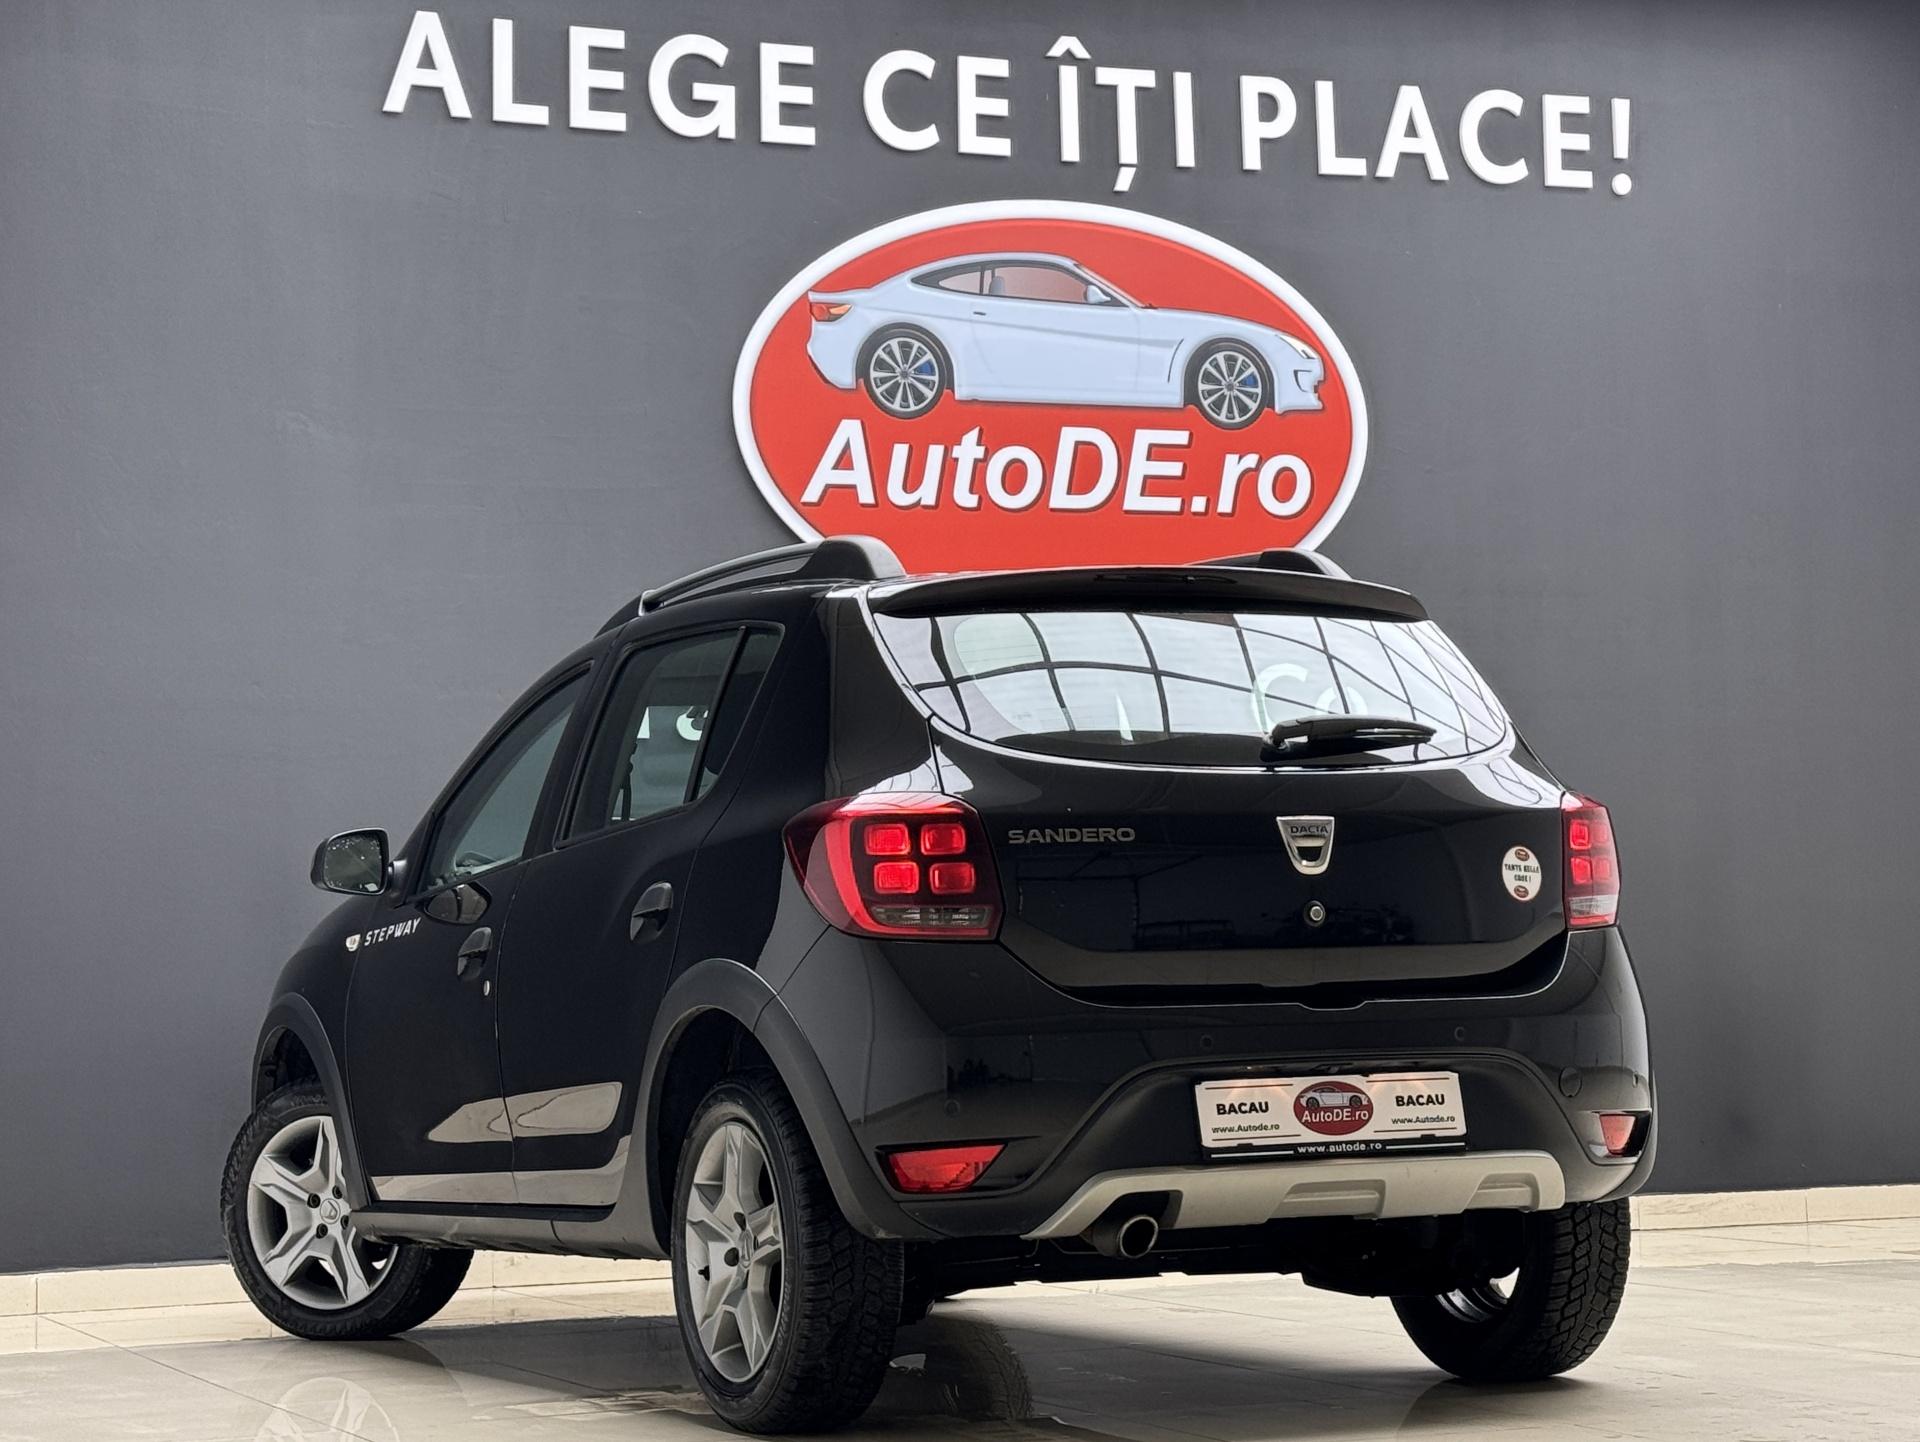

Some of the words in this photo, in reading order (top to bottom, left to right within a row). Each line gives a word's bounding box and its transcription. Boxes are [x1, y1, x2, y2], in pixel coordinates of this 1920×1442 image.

[382, 10, 816, 146] ALEGE
[863, 49, 1012, 157] CE
[1045, 35, 1196, 192] ÎȚI
[1239, 74, 1633, 196] PLACE!
[801, 418, 1313, 517] AutoDE.ro
[1007, 827, 1136, 844] SANDERO
[1290, 825, 1329, 834] DACIA
[364, 917, 422, 946] STEPWAY
[1395, 1094, 1446, 1107] BACAU
[1216, 1101, 1269, 1116] BACAU
[1301, 1107, 1370, 1123] AutoDE.ro
[1391, 1113, 1456, 1125] www.Autode.ro
[1211, 1122, 1280, 1134] www.Autode.ro
[1297, 1141, 1383, 1154] www.autode.ro
